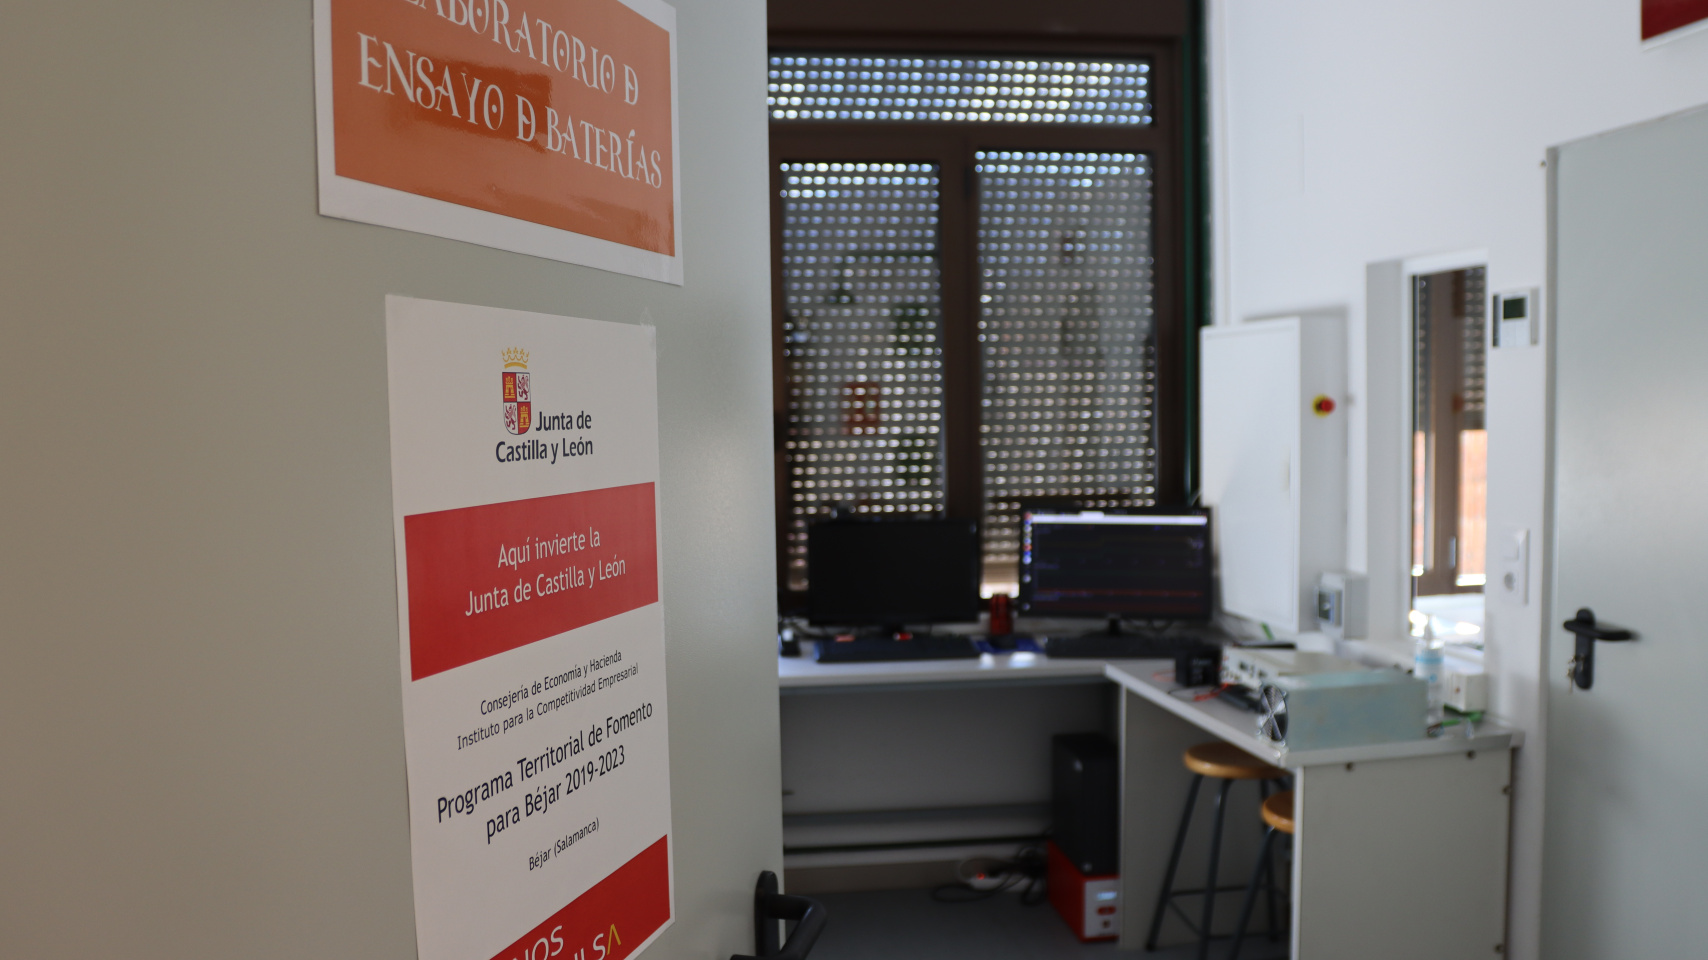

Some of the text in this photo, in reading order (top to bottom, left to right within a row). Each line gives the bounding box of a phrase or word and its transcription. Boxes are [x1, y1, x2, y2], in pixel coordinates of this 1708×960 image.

[402, 0, 616, 94] BORATORIO
[357, 32, 504, 131] ENSAYO
[545, 106, 662, 189] BATERÍAS
[495, 437, 593, 464] Castilla y León
[536, 411, 592, 432] Junta de
[498, 526, 601, 570] Aquí invierte la
[465, 554, 626, 617] Junta de Castilla y León
[457, 661, 639, 750] Instituto para la Competitividad Empresarial
[480, 650, 622, 715] Consejería de Economía y Hacienda
[437, 702, 653, 823] Programa Territorial de Fomento
[486, 745, 625, 845] para Béjar 2019-2023
[529, 817, 600, 871] Béjar (Salamanca)
